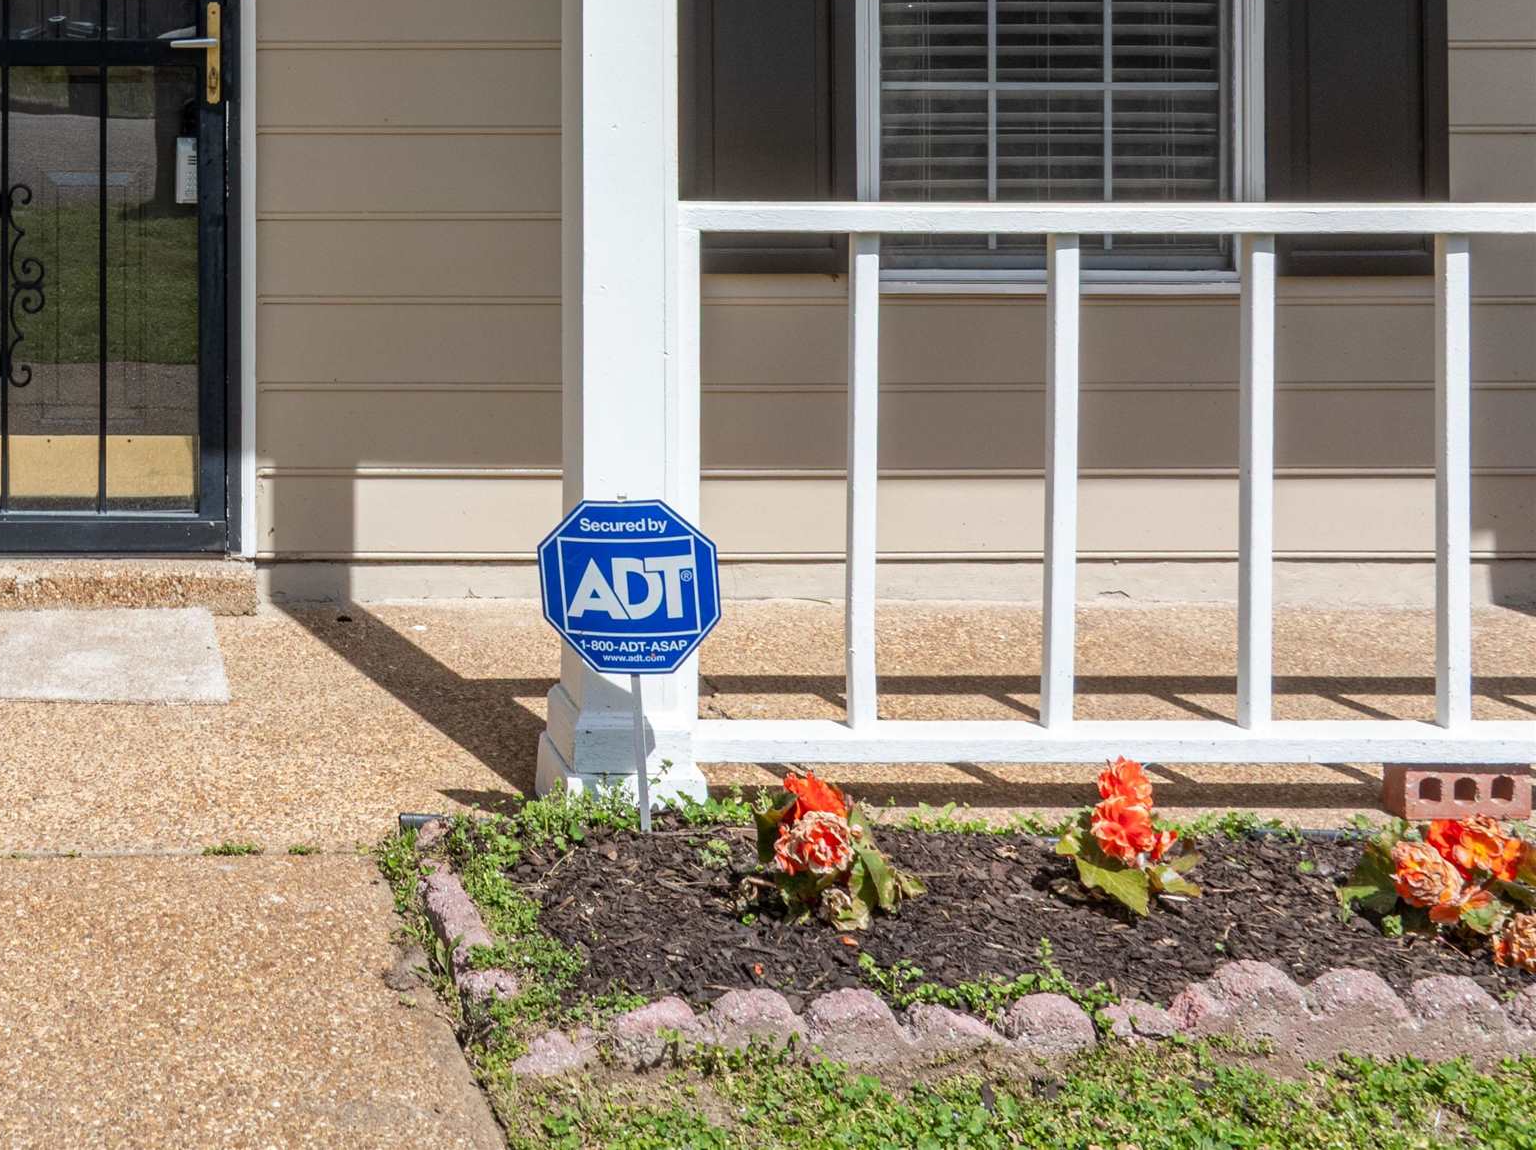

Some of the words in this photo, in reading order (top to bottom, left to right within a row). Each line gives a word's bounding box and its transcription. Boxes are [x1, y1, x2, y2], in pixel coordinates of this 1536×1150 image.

[579, 517, 646, 532] Secured
[648, 517, 668, 533] by
[567, 554, 694, 620] ADT
[580, 639, 688, 653] 1-800-ADT-ASAP
[602, 653, 666, 662] www.adt.com
